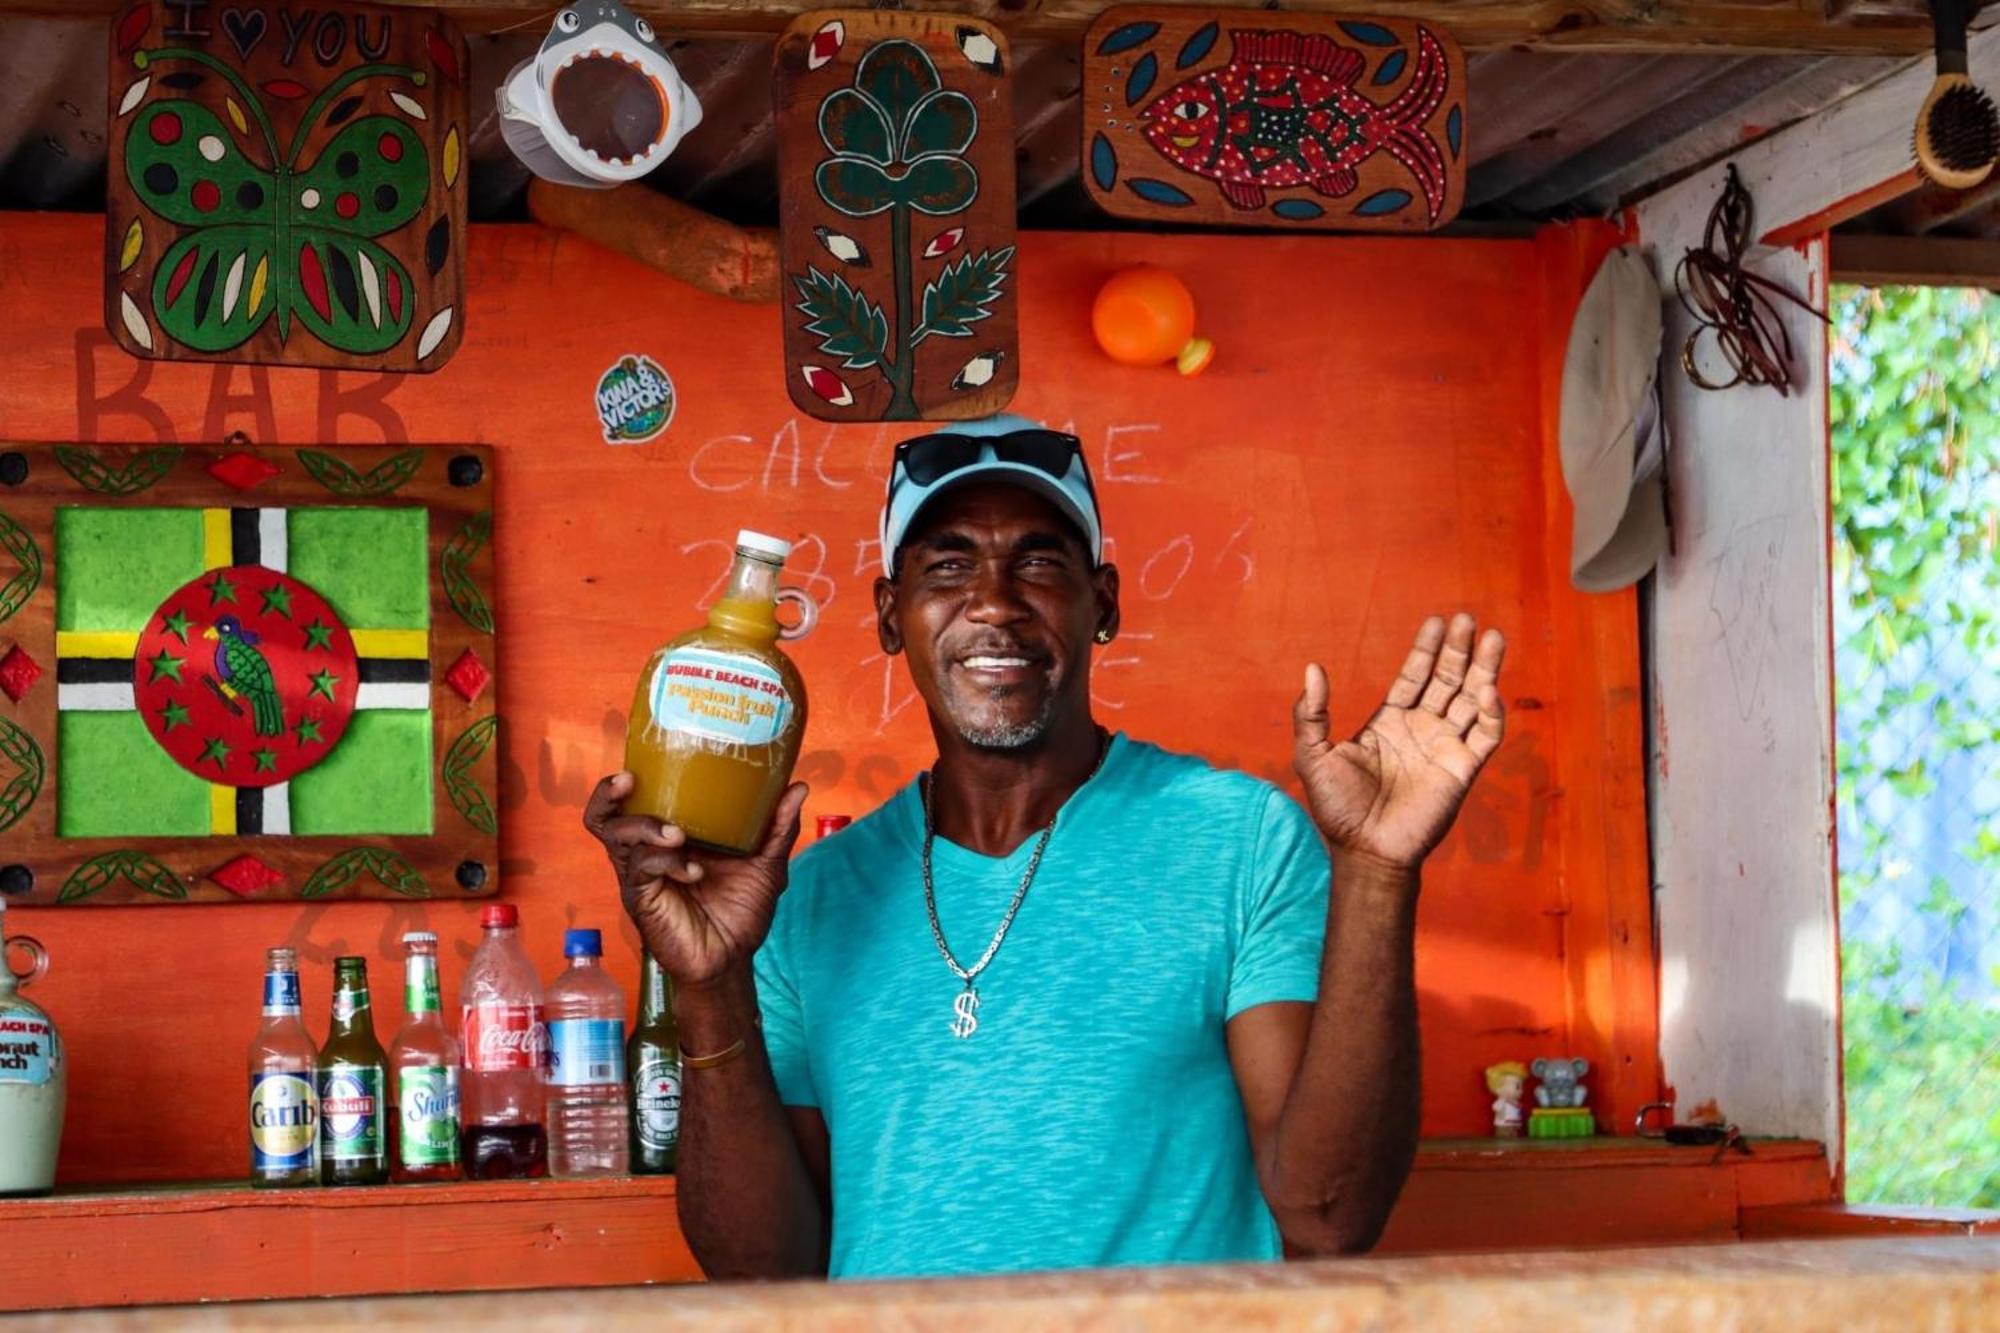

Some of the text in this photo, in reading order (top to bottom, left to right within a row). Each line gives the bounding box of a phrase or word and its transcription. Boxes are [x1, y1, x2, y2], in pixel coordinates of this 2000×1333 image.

[164, 0, 391, 65] I YOU
[600, 376, 641, 412] KINA
[689, 419, 888, 493] CALL
[666, 664, 786, 699] BUBBLE BEACH SPA
[0, 1021, 26, 1033] ACH
[252, 1099, 316, 1129] Carib
